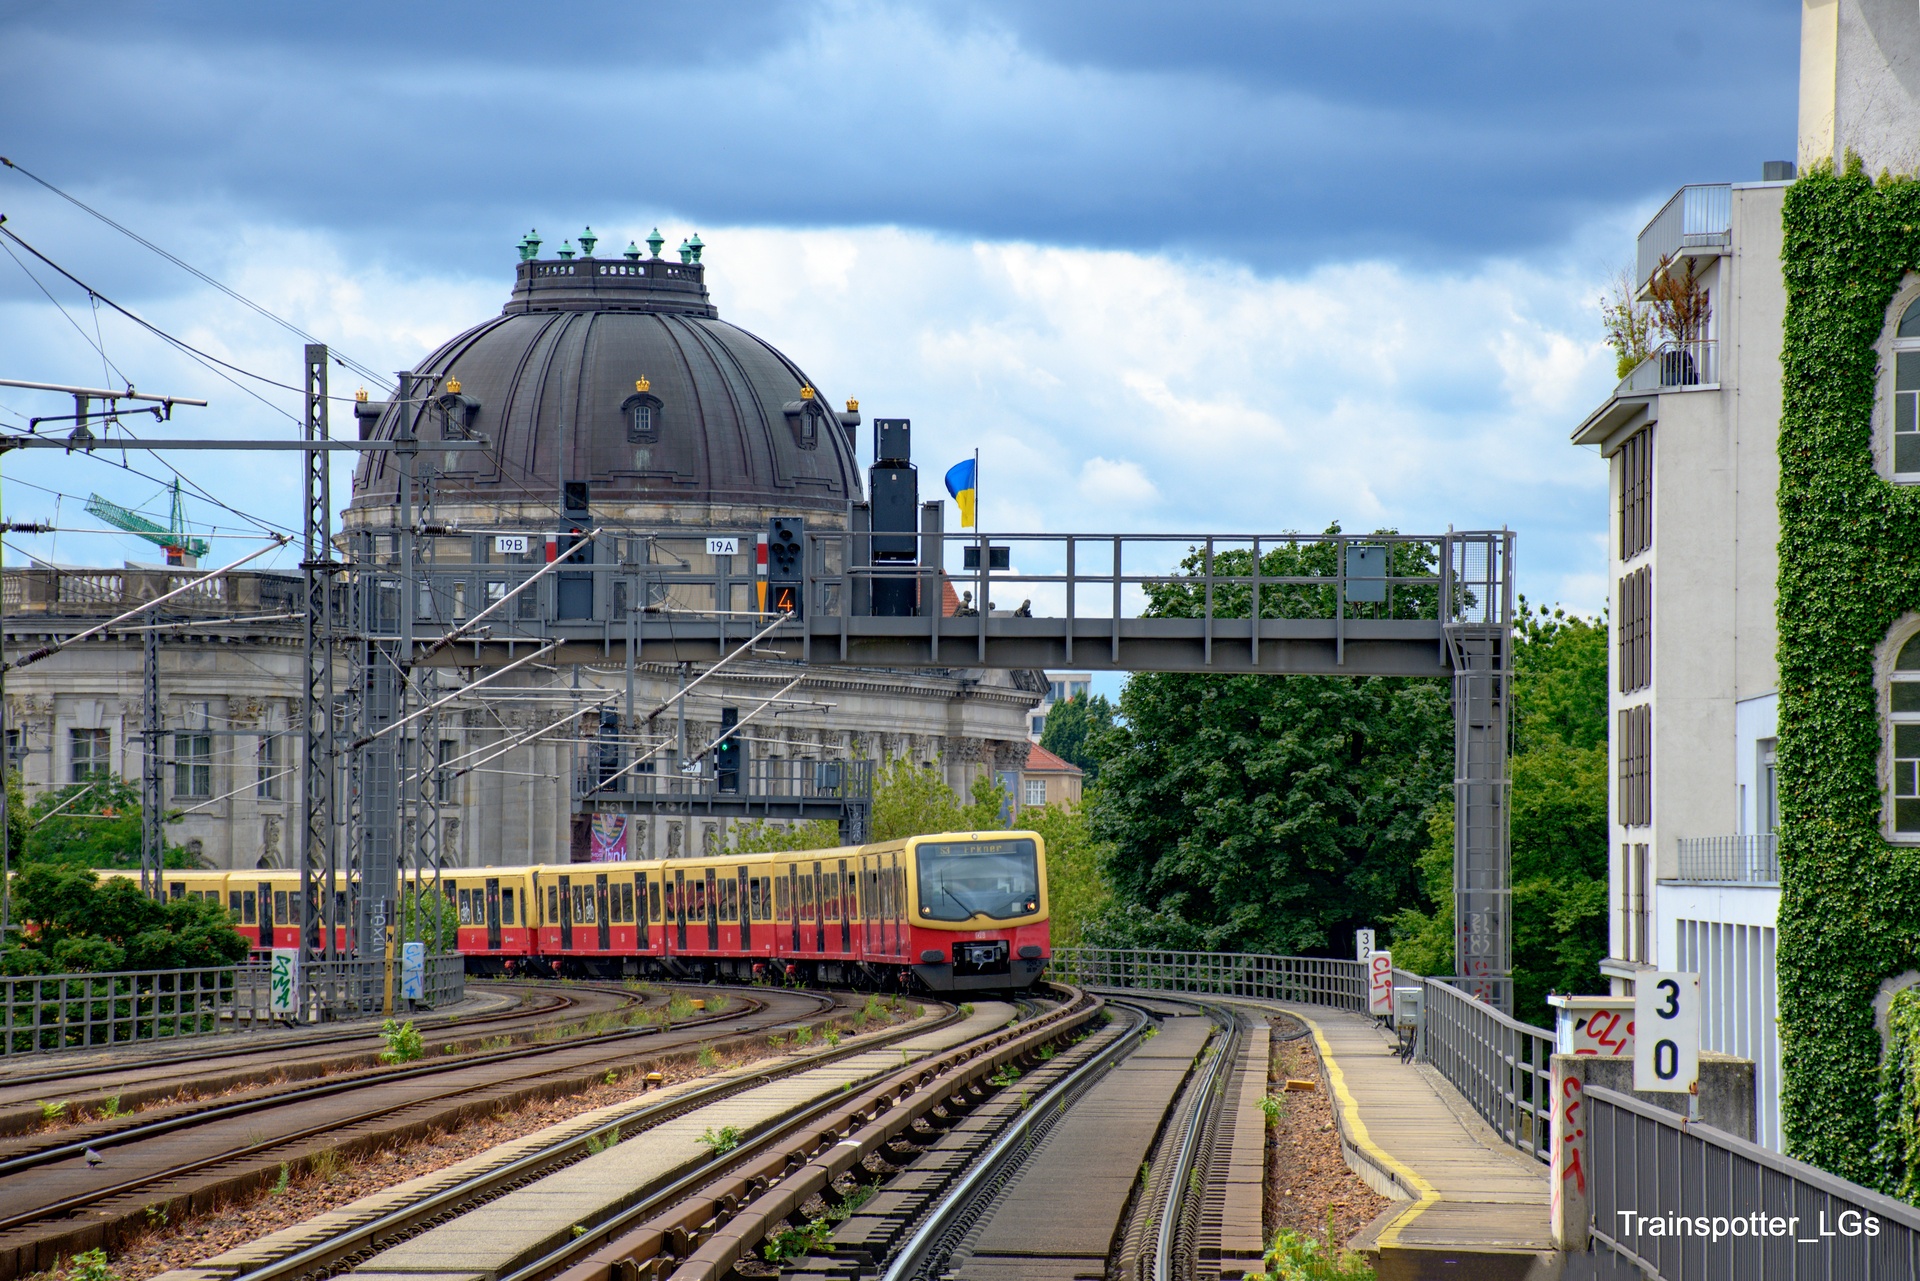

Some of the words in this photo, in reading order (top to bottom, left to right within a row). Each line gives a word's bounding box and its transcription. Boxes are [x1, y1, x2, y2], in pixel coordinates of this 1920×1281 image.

[500, 540, 523, 551] 19B
[711, 541, 734, 552] 19A
[778, 589, 793, 612] 4
[964, 845, 1002, 853] Erkner
[1362, 932, 1370, 945] 3
[1363, 947, 1370, 959] 2
[1655, 979, 1680, 1020] 3
[1654, 1039, 1679, 1081] 0
